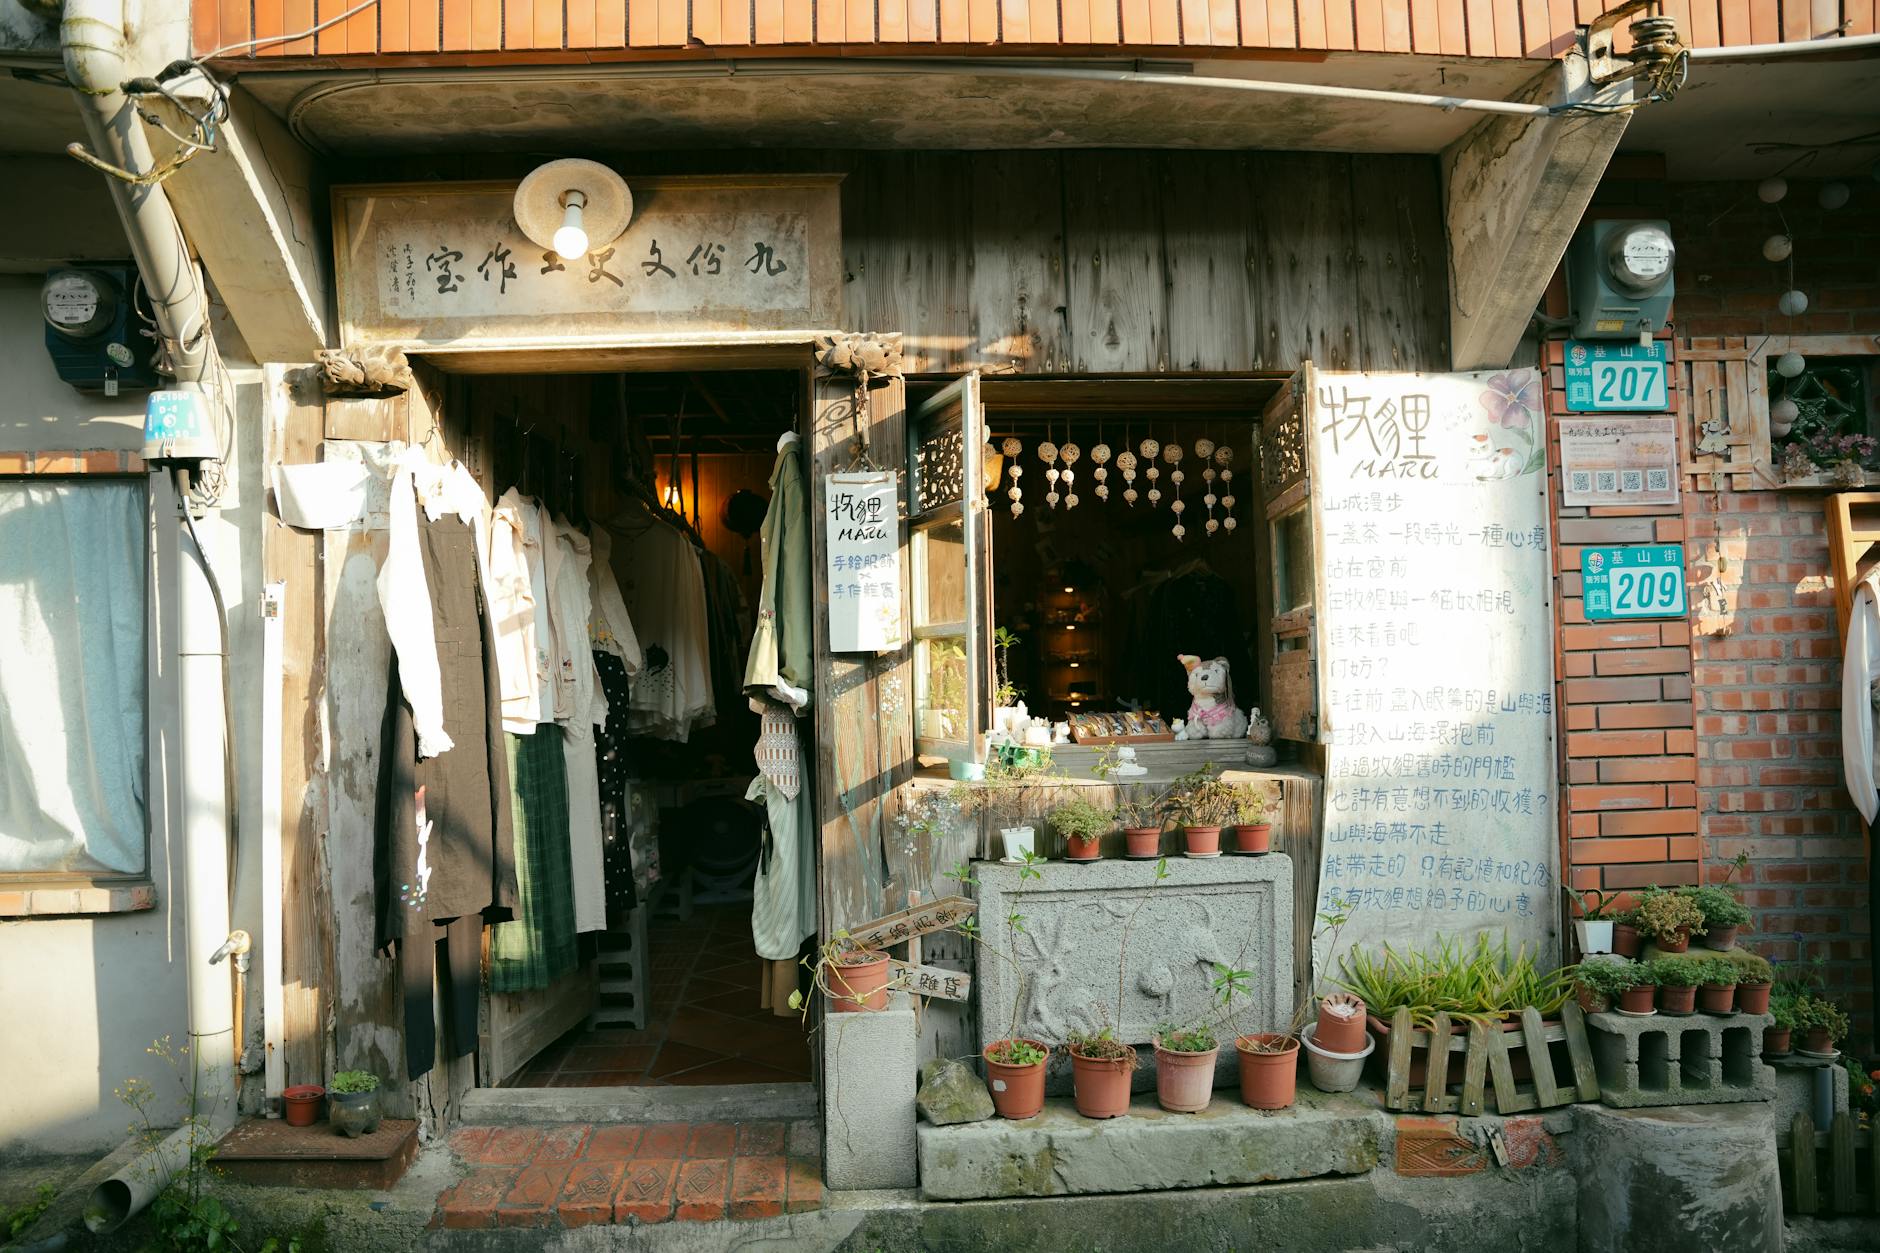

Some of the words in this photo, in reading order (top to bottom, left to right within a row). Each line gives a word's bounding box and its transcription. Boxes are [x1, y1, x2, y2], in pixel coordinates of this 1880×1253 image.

[1594, 344, 1659, 358] 基山街
[1599, 366, 1659, 402] 207
[1350, 459, 1440, 480] MARU
[1324, 492, 1404, 514] 山城漫步
[838, 527, 888, 545] MARU
[1612, 549, 1677, 565] 基山街
[1585, 574, 1608, 584] 瑞芳區
[1616, 571, 1677, 609] 209
[1329, 821, 1451, 846] 山與海帶不走
[1324, 853, 1406, 879] 能帶走的
